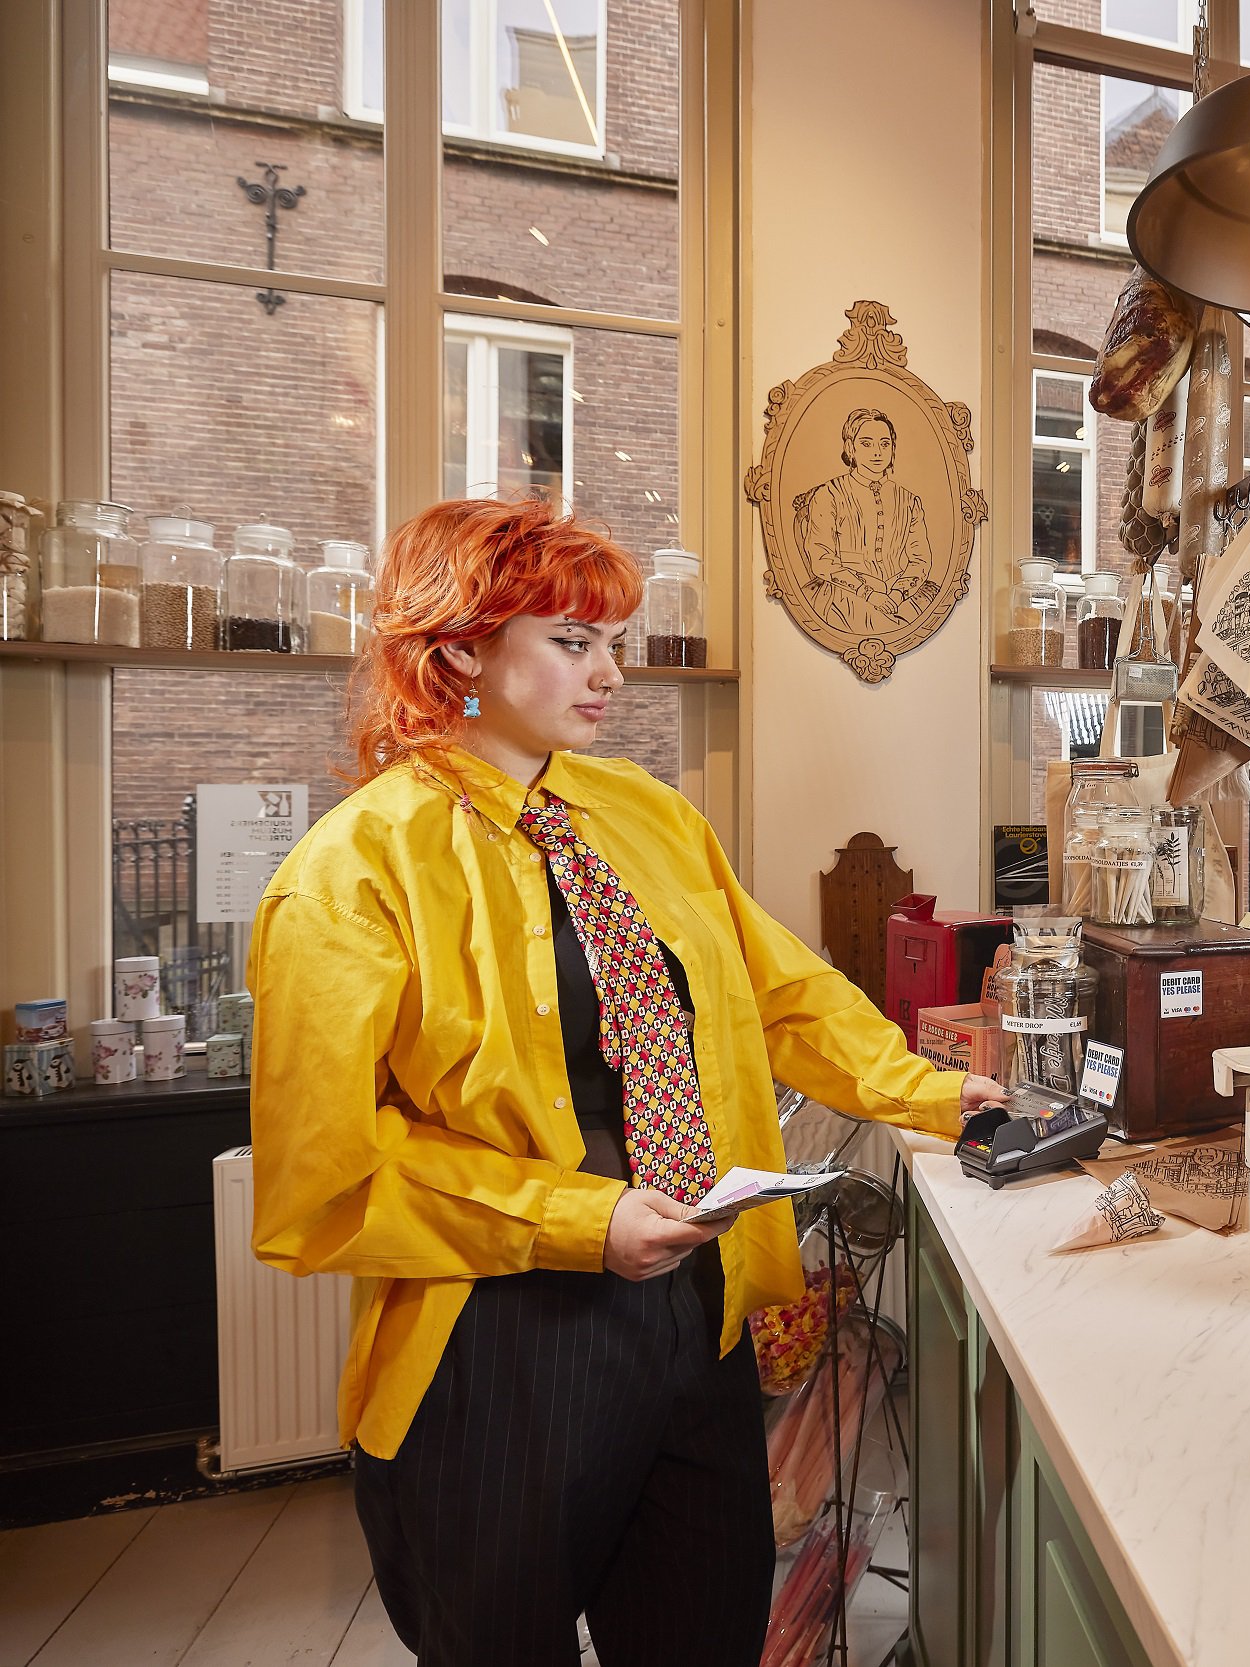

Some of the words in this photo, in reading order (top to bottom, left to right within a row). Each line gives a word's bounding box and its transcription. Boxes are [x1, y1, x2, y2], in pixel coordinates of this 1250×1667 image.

[1162, 977, 1182, 987] DEBIT
[1182, 976, 1201, 986] CARD
[1162, 986, 1175, 996] YES
[1176, 984, 1201, 995] PLEASE
[920, 1045, 970, 1072] OUDHOLLANDS
[1087, 1048, 1105, 1062] DEBIT
[1104, 1053, 1120, 1067] CARD
[1086, 1058, 1097, 1072] YES
[1097, 1062, 1119, 1078] PLEASE
